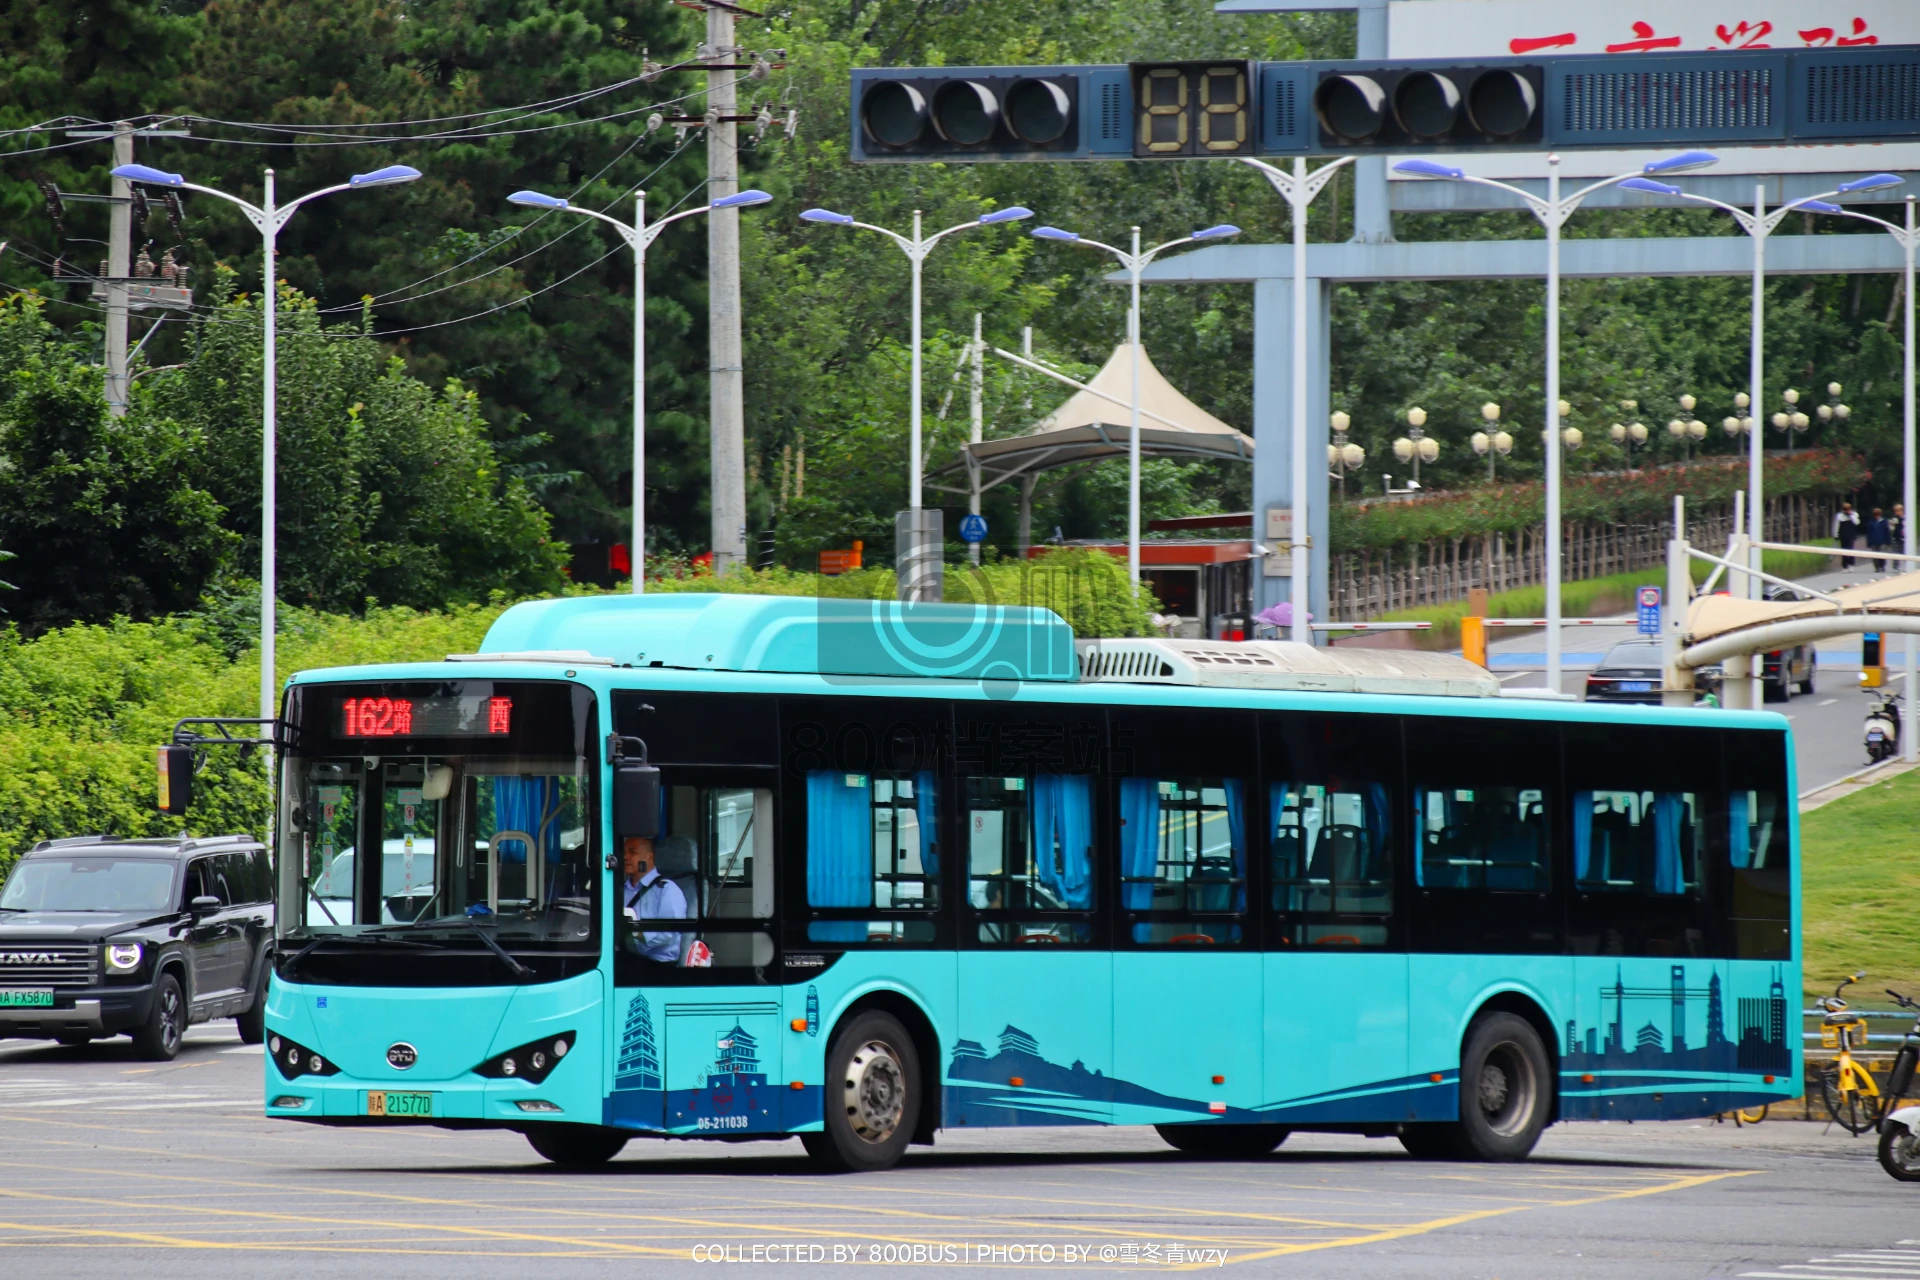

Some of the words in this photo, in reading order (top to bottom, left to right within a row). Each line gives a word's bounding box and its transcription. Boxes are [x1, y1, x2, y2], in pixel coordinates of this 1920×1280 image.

[344, 697, 412, 736] 162路
[490, 697, 512, 733] 西
[15, 991, 52, 1004] FX5870
[388, 1096, 430, 1114] 21577D
[698, 1115, 748, 1130] 05-211038
